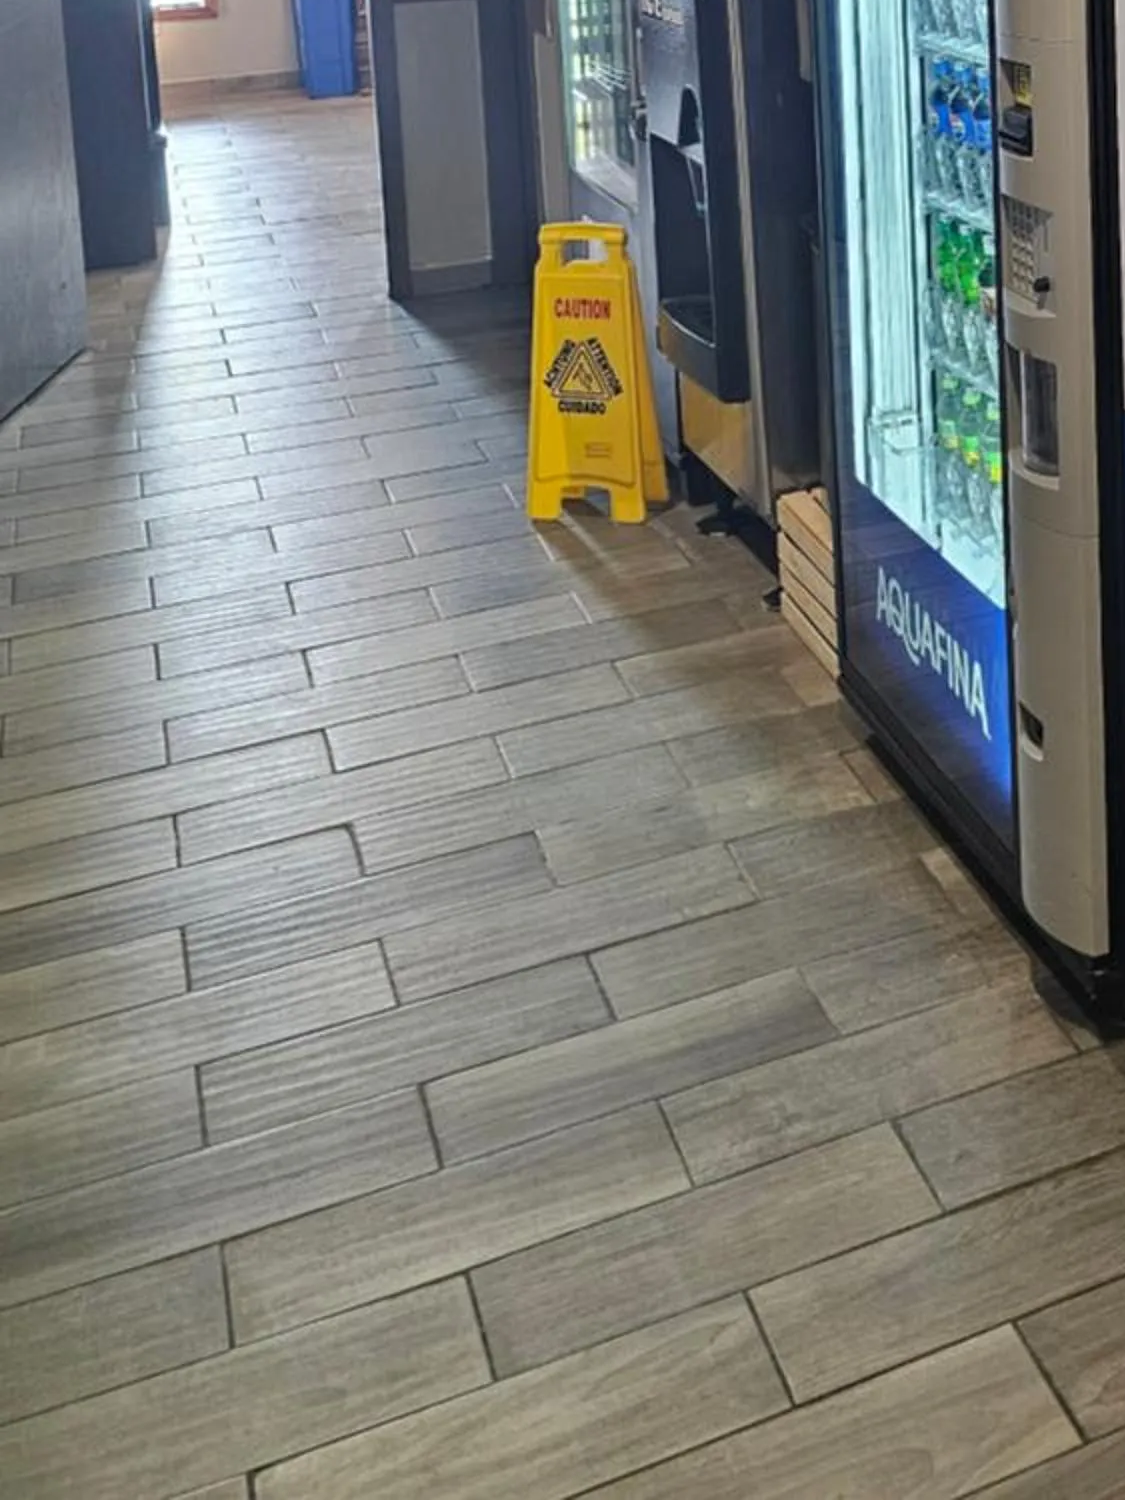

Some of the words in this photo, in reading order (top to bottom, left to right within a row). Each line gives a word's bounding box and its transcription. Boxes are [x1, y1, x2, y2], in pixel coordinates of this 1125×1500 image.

[555, 297, 611, 319] CAUTION
[557, 400, 607, 415] CUIDADO
[875, 565, 992, 742] AQUAFINA
